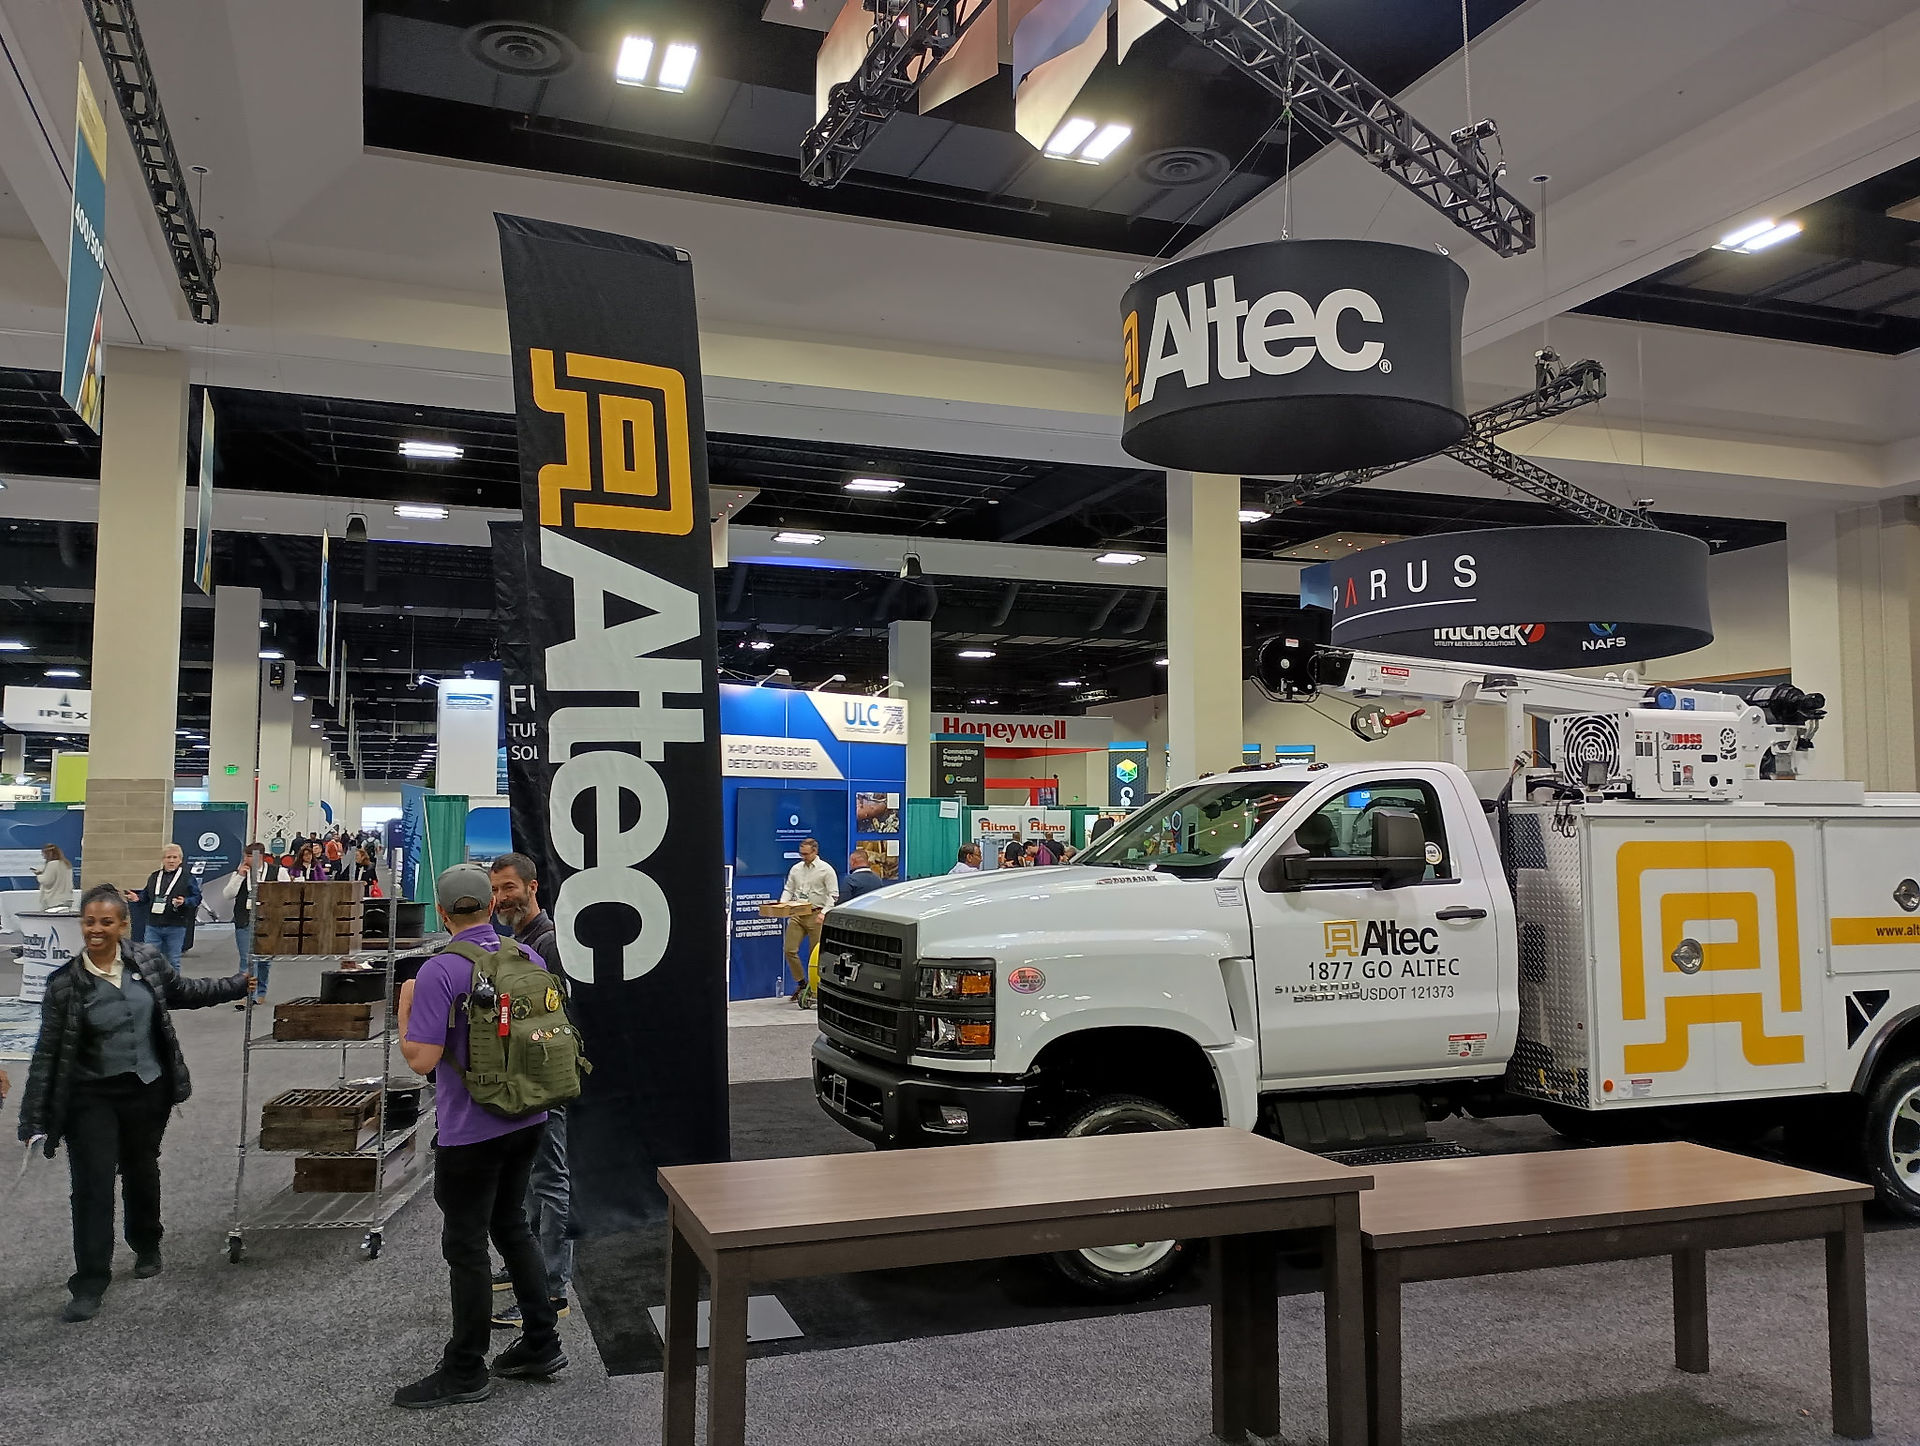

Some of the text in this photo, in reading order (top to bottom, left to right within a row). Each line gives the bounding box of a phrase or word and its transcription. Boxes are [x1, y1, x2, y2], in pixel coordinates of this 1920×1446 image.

[75, 202, 104, 270] 400/500
[1582, 637, 1627, 651] NAFS
[39, 709, 89, 720] IPEX
[844, 701, 880, 727] ULC
[942, 717, 1067, 744] Honeywell
[1674, 733, 1703, 744] BOSS
[539, 526, 705, 985] Altec
[754, 745, 787, 756] CROSS
[787, 747, 812, 757] BORE
[942, 748, 979, 756] Connecting
[728, 758, 818, 771] DETECTION SENSOR
[981, 822, 1016, 832] Ritmo
[1030, 822, 1066, 832] Ritmo
[1360, 920, 1439, 956] Altec
[1308, 957, 1460, 980] 1877 GO ALTEC
[1274, 981, 1361, 995] SILVERADO
[1360, 985, 1455, 1001] USDOT 121373
